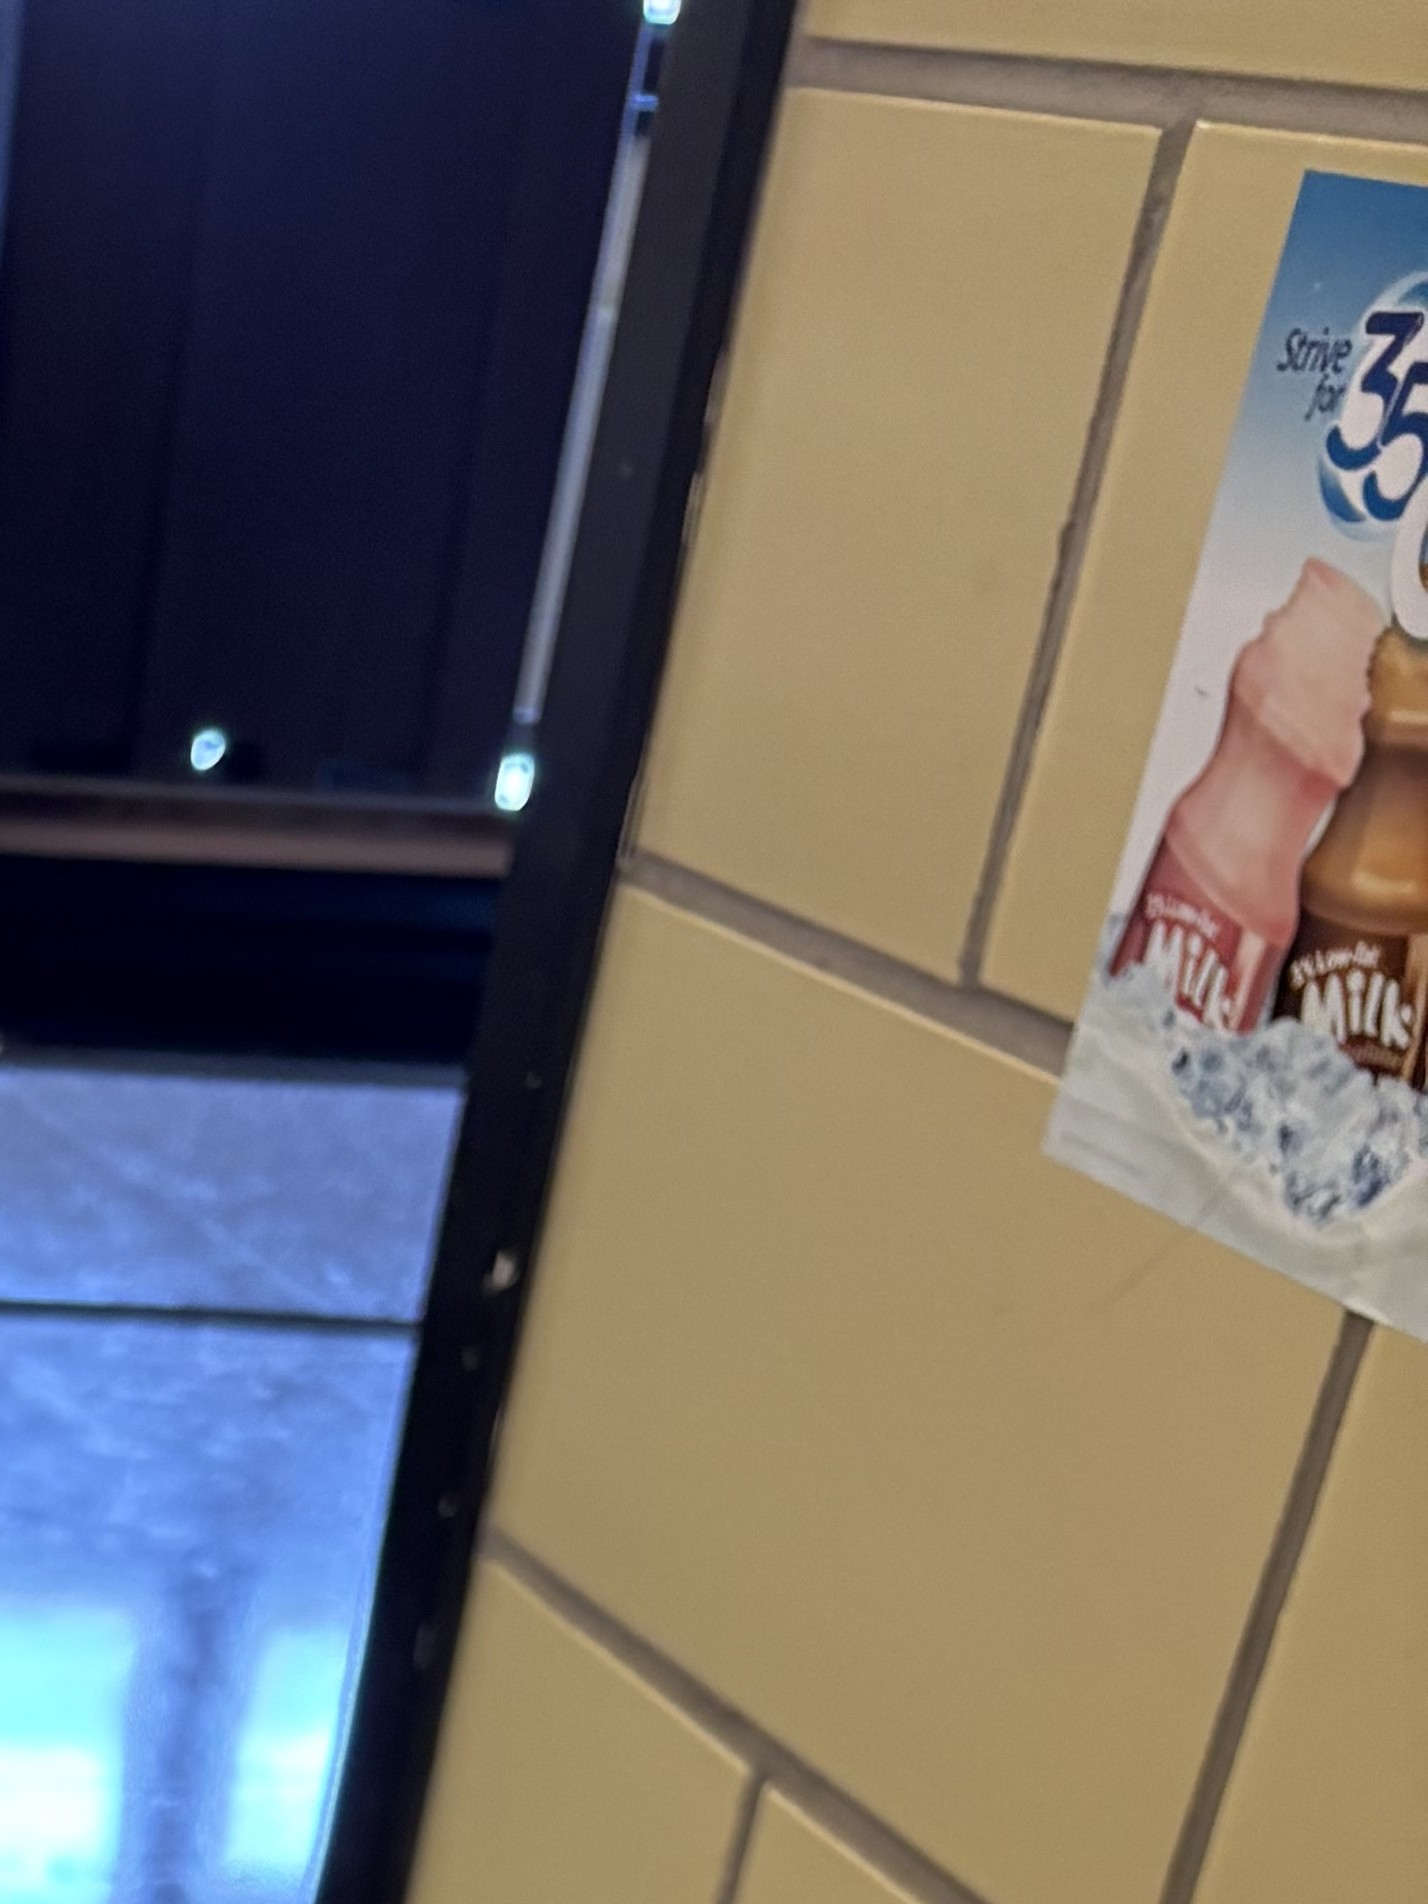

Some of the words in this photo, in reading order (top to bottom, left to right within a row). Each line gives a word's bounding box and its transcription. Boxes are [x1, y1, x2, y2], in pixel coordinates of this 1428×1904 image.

[1276, 326, 1353, 373] Strive
[1304, 373, 1346, 421] for
[1144, 919, 1234, 1034] Milk
[1301, 968, 1412, 1050] Milk
